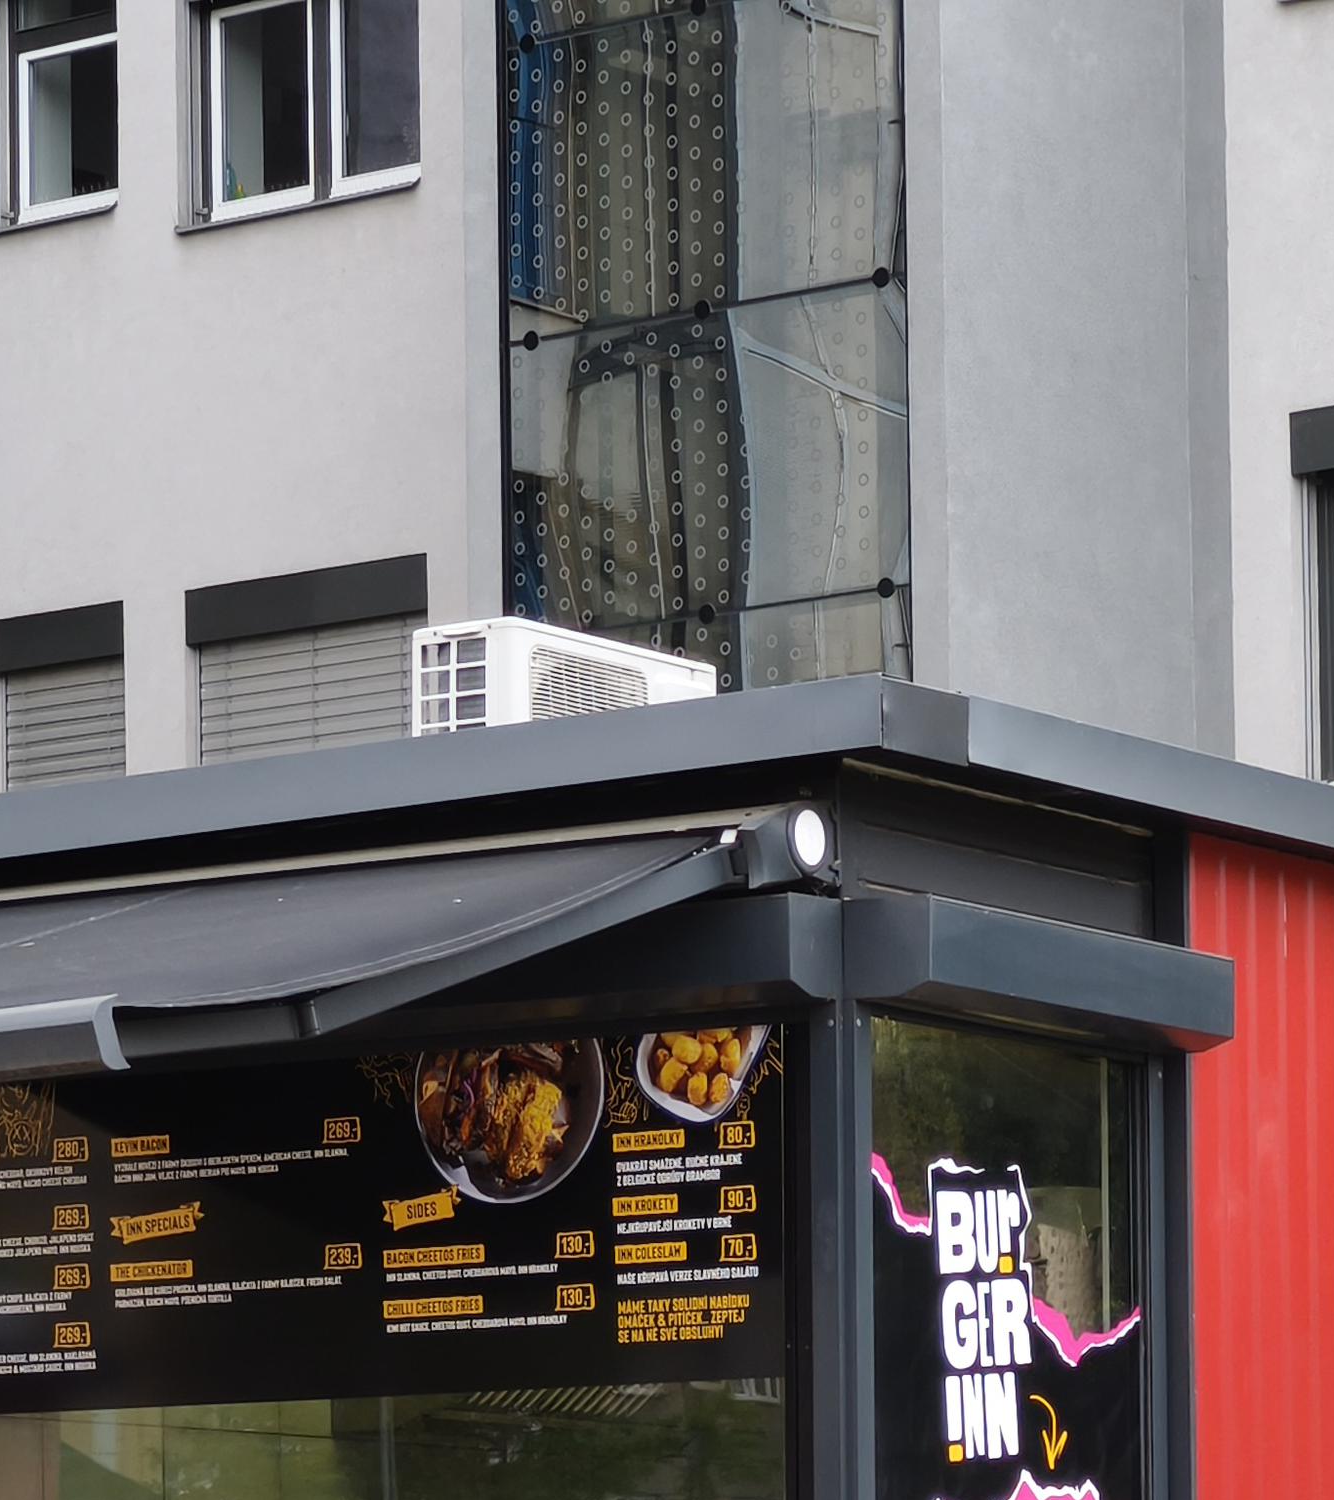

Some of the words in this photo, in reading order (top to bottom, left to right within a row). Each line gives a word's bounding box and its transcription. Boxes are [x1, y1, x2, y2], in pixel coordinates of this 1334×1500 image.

[114, 1141, 138, 1153] KEVIN
[140, 1139, 168, 1151] BACON
[616, 1135, 631, 1148] INN
[634, 1131, 682, 1146] HRANOLKY
[407, 1201, 437, 1219] SIDES
[617, 1201, 632, 1213] INN
[634, 1197, 676, 1212] KROKETY
[126, 1221, 142, 1236] INN
[145, 1214, 190, 1233] SPECIALS
[386, 1250, 415, 1265] BACON
[416, 1248, 454, 1262] CHEETOS
[457, 1247, 481, 1260] FRIES
[618, 1248, 633, 1261] INN
[635, 1245, 682, 1260] COLESLAW
[115, 1266, 129, 1278] THE
[132, 1263, 187, 1277] CHICKENATOR
[387, 1302, 414, 1315] CHILLI
[415, 1300, 453, 1314] CHEETOS
[456, 1299, 480, 1312] FRIES
[617, 1299, 646, 1314] MÁME
[647, 1298, 671, 1313] TAKY
[672, 1295, 708, 1311] SOLIDNÍ
[709, 1293, 750, 1309] NABÍDKU
[618, 1312, 655, 1328] OMÁČEK
[658, 1313, 667, 1327] &
[710, 1309, 745, 1324] ZEPTEJ
[618, 1330, 630, 1343] SE
[631, 1329, 645, 1342] NA
